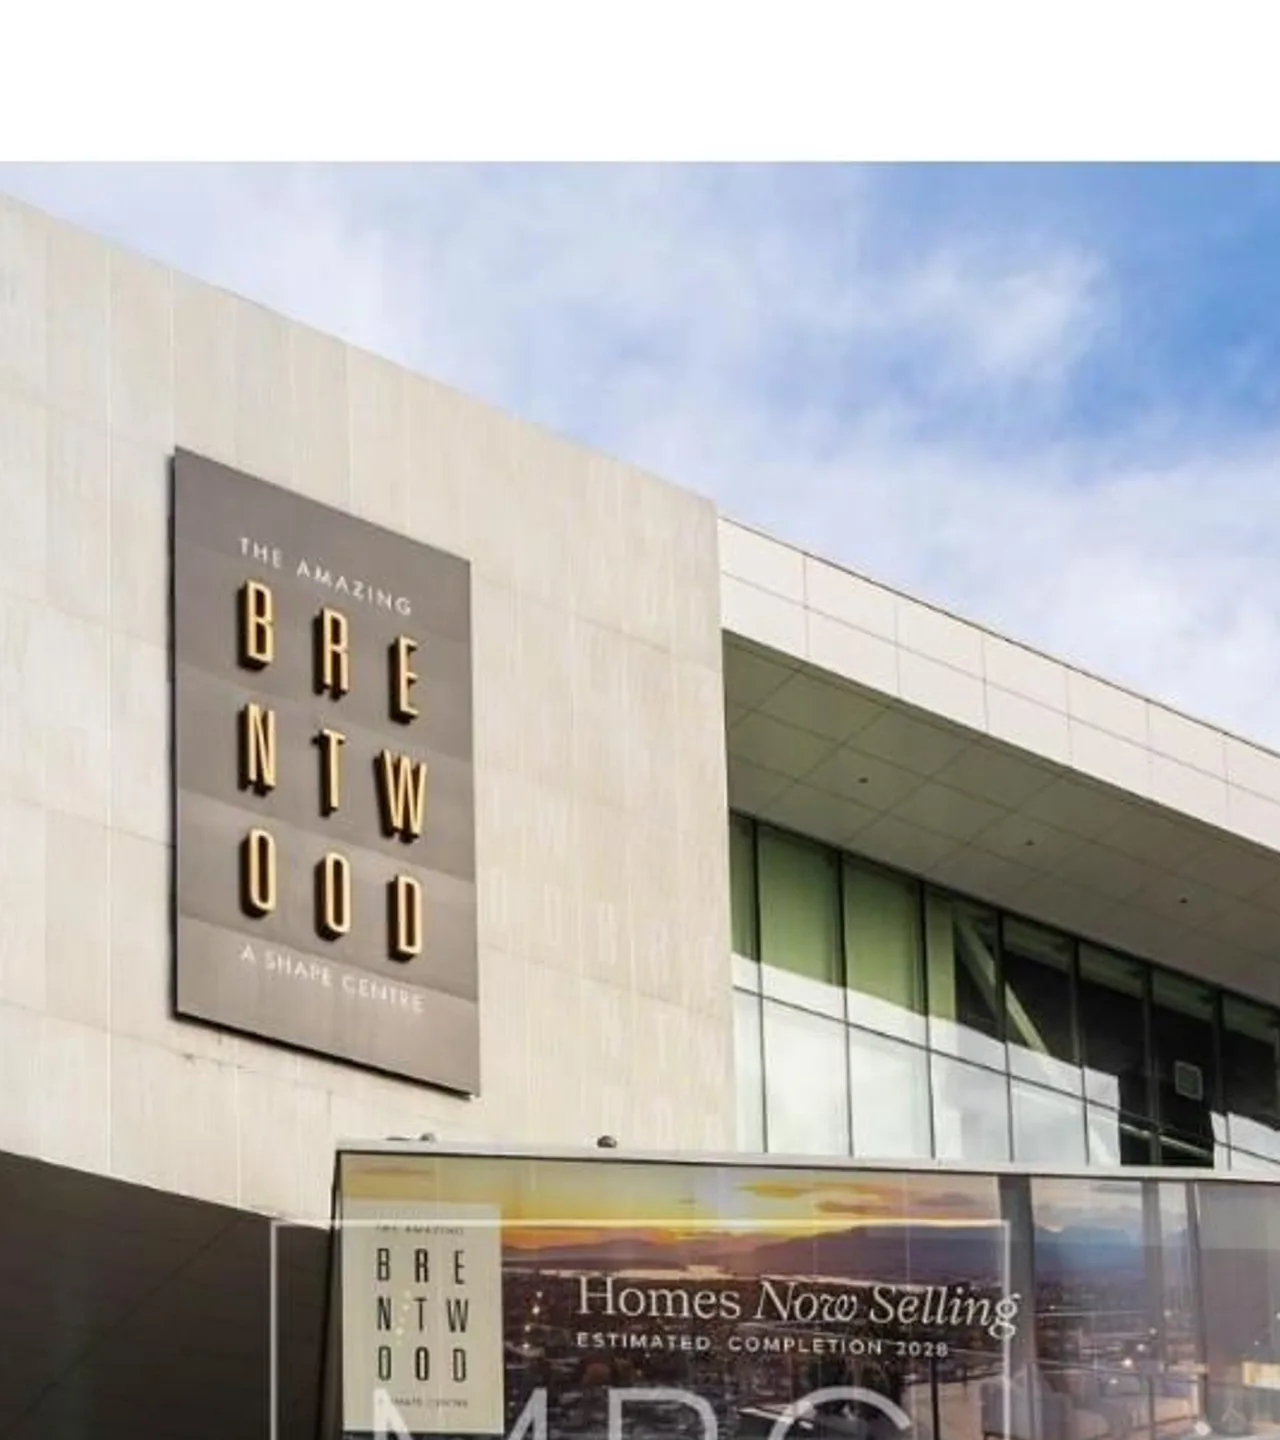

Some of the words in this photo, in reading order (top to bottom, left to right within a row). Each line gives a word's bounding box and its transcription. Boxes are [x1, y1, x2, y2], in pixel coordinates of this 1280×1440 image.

[240, 537, 282, 568] THE
[296, 559, 412, 616] AMAZING
[240, 943, 257, 964] A
[265, 950, 333, 988] SHAPE
[342, 975, 426, 1014] CENTRE
[577, 1274, 741, 1320] Homes
[757, 1281, 858, 1323] Now
[869, 1284, 1022, 1340] Selling
[577, 1332, 712, 1352] ESTIMATED
[728, 1335, 882, 1356] COMPLETION
[896, 1341, 949, 1358] 2028
